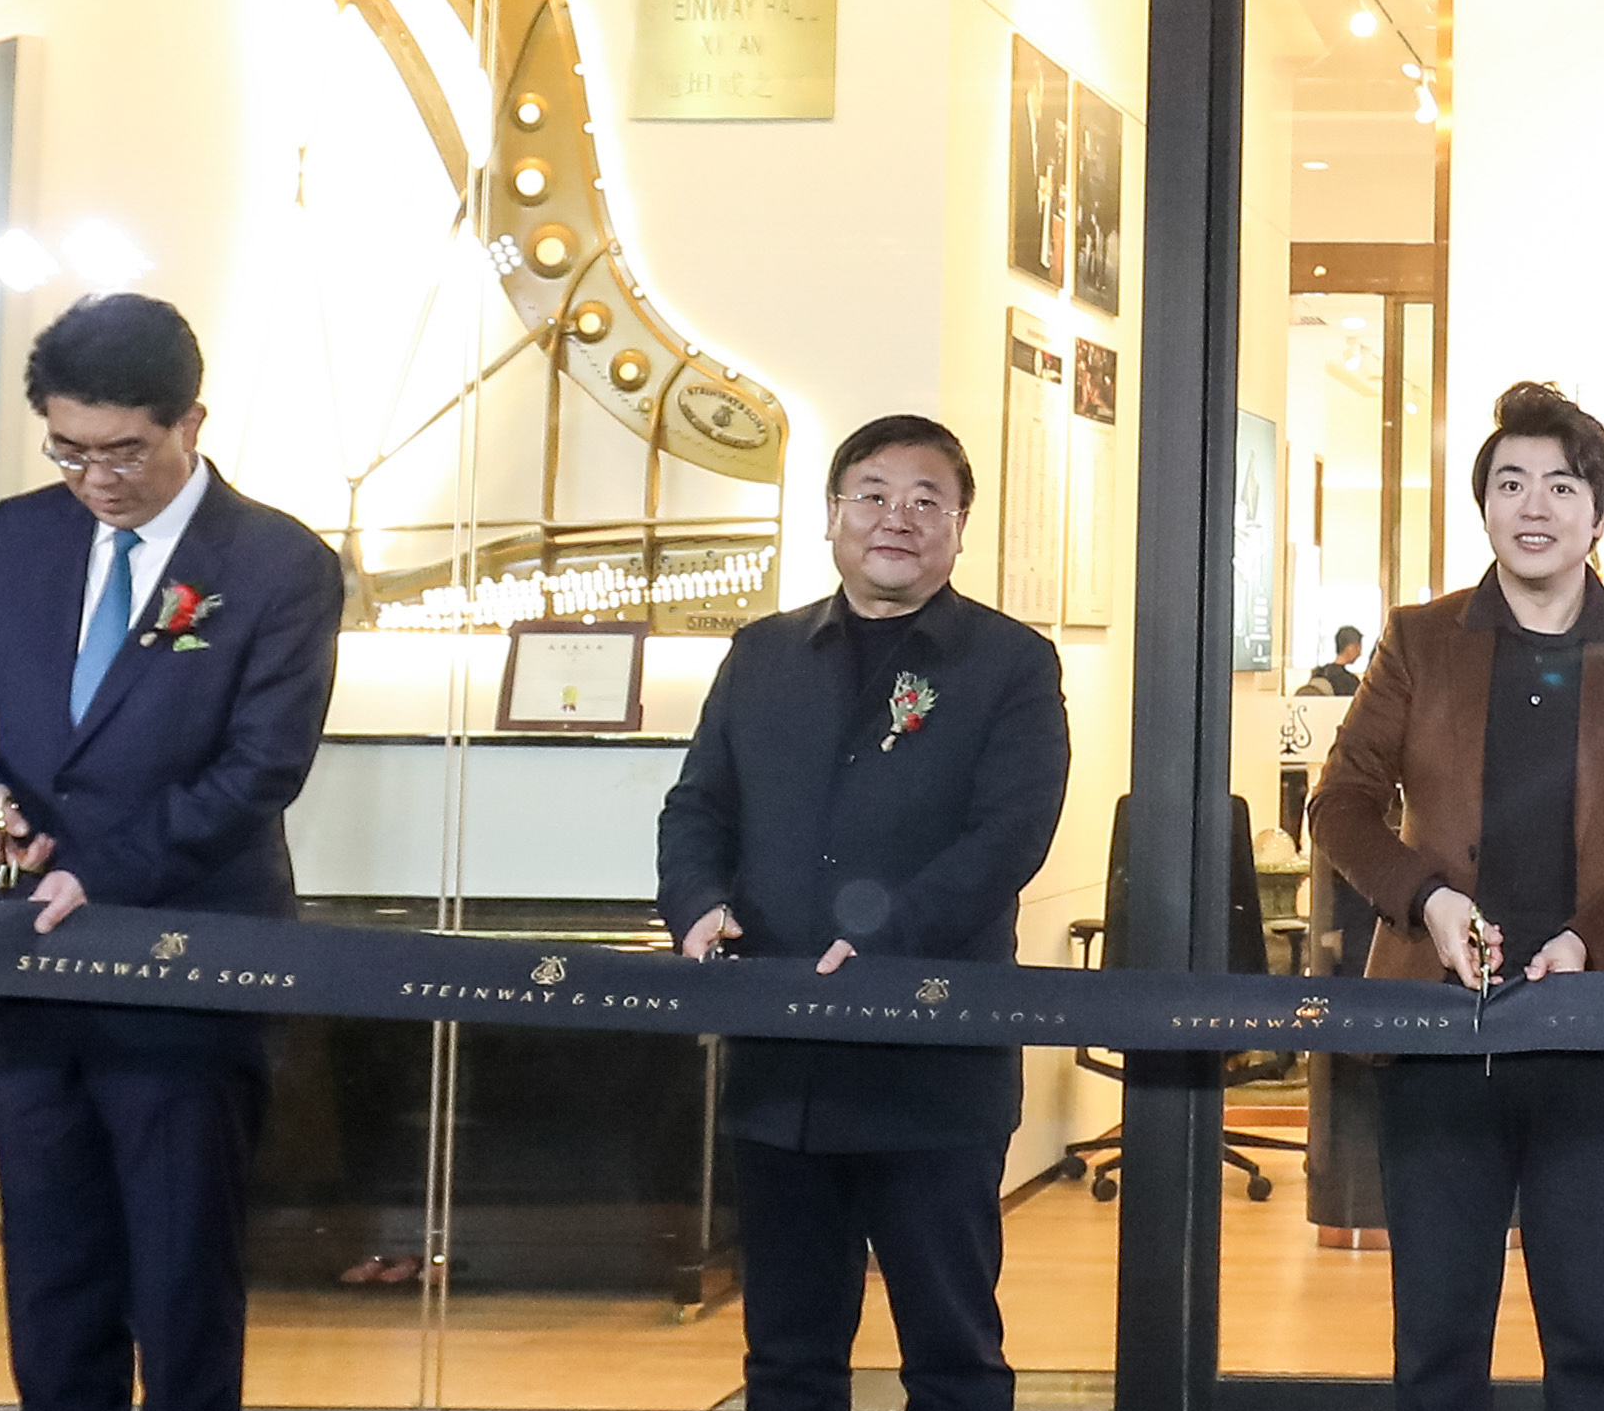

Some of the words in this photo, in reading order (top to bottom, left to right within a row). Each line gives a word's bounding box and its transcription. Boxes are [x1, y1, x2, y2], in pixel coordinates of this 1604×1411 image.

[16, 955, 170, 979] STEINWAY
[187, 967, 200, 981] &
[217, 970, 296, 988] SONS
[400, 982, 555, 1004] STEINWAY
[572, 992, 585, 1006] &
[602, 994, 680, 1011] SONS
[786, 1002, 940, 1021] STEINWAY
[1171, 1017, 1324, 1029] STEINWAY
[1373, 1016, 1449, 1028] SONS
